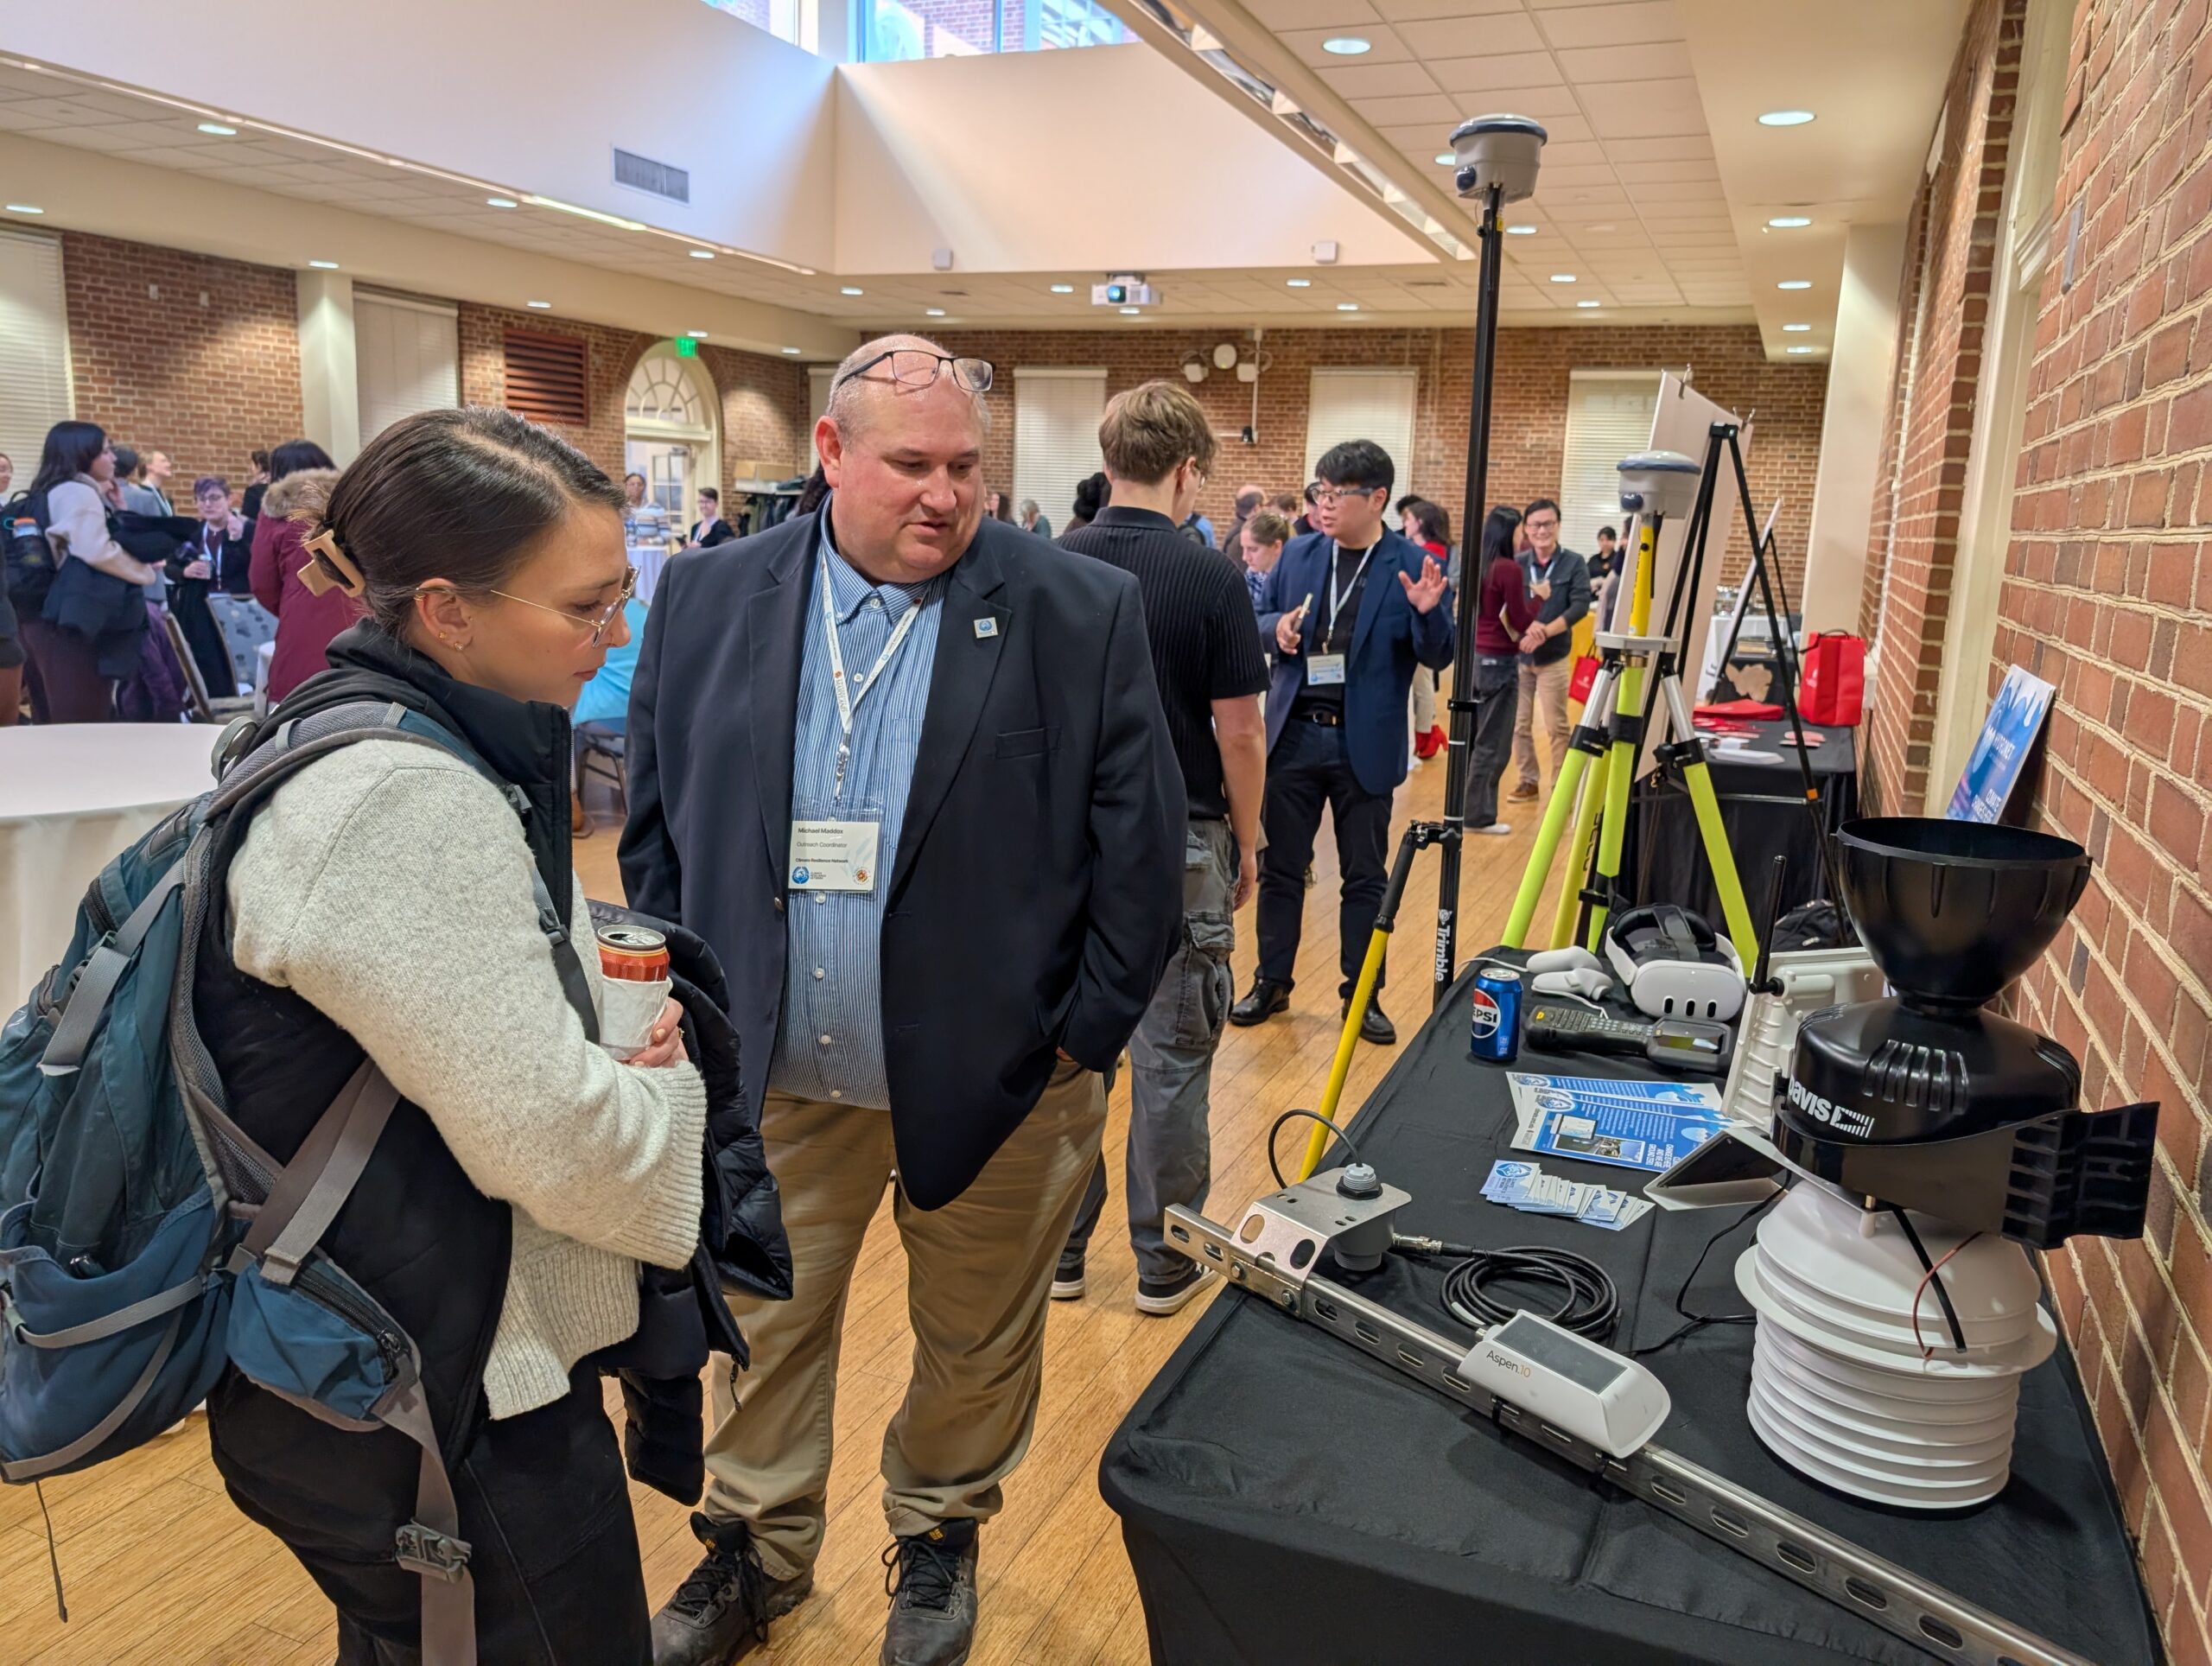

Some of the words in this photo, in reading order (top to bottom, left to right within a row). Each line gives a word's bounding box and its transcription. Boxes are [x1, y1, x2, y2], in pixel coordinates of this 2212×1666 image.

[1435, 925, 1450, 982] Trimble
[1472, 1007, 1497, 1023] EPSI
[1486, 1350, 1531, 1377] Aspen.10
